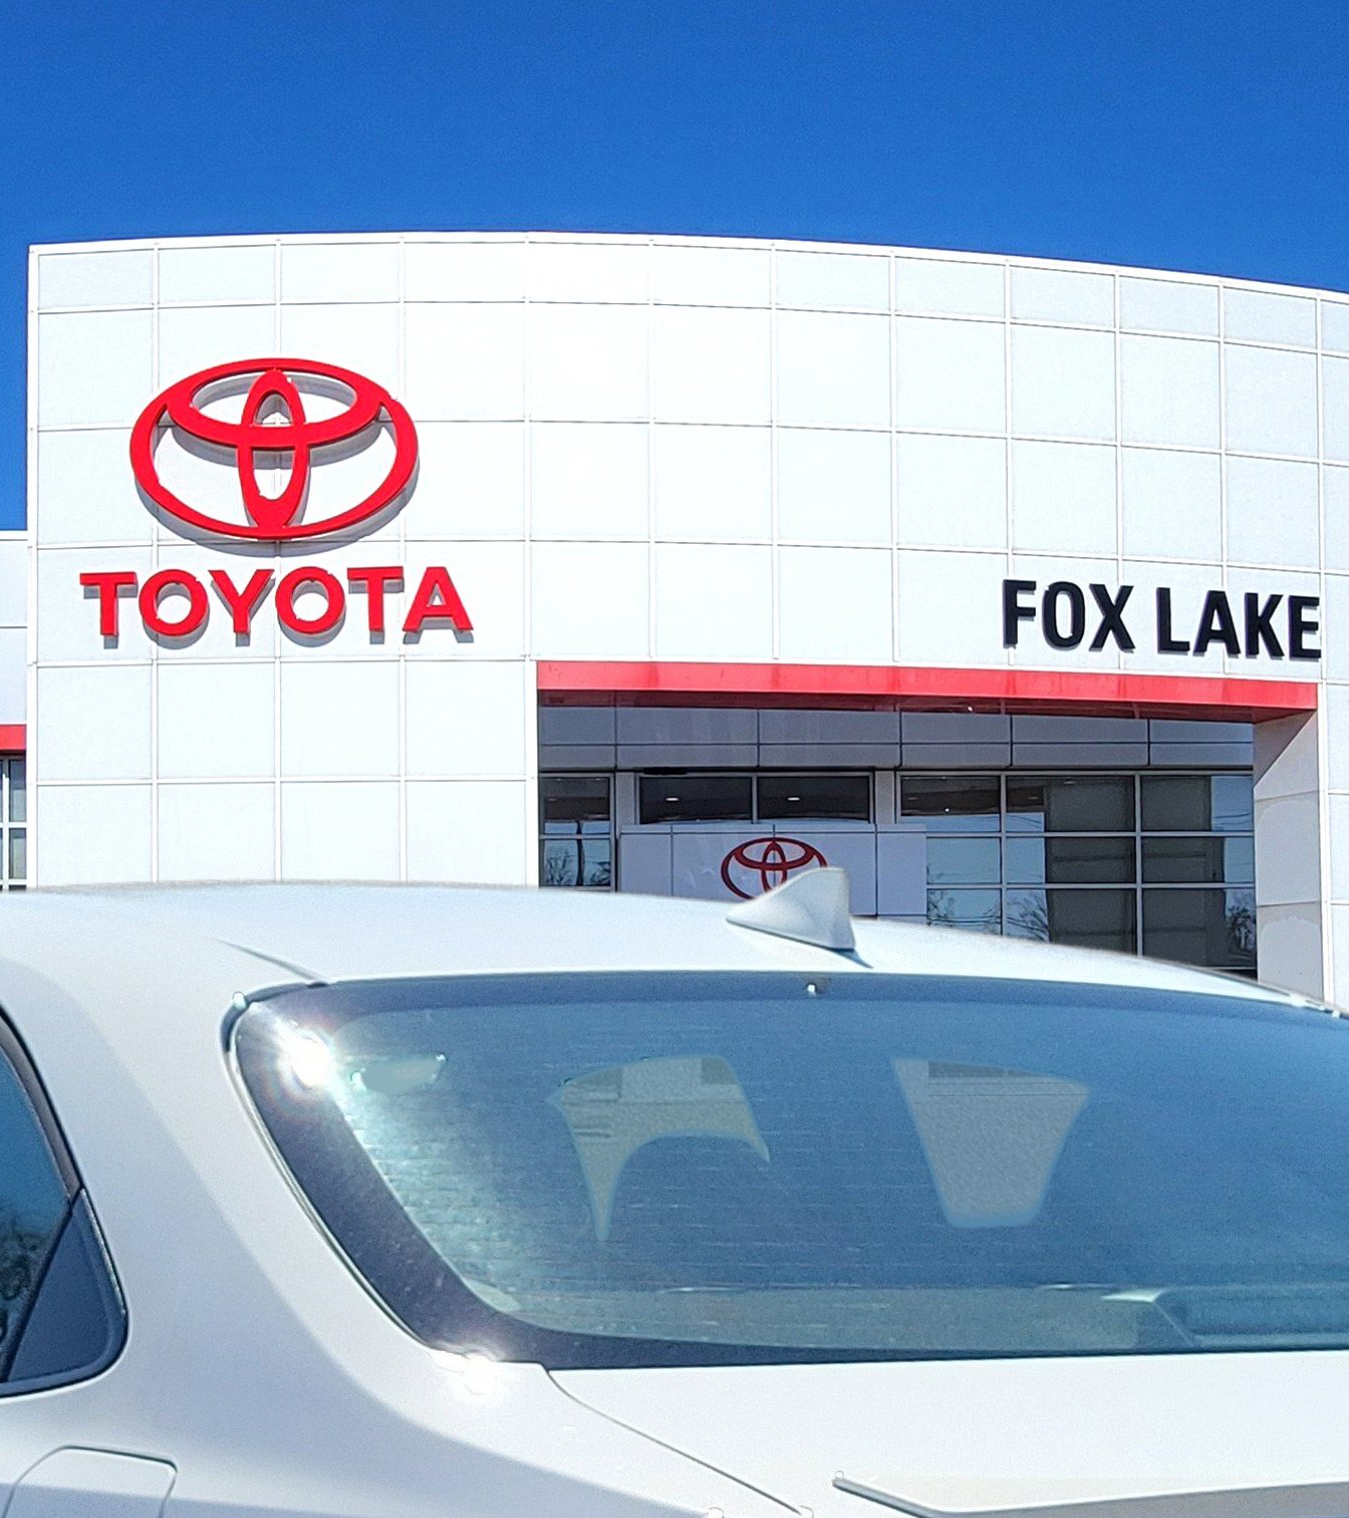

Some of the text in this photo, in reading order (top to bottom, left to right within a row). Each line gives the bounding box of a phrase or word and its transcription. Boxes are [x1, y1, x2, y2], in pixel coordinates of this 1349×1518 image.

[79, 566, 474, 636] TOYOTA
[1003, 579, 1322, 659] FOX LAKE
